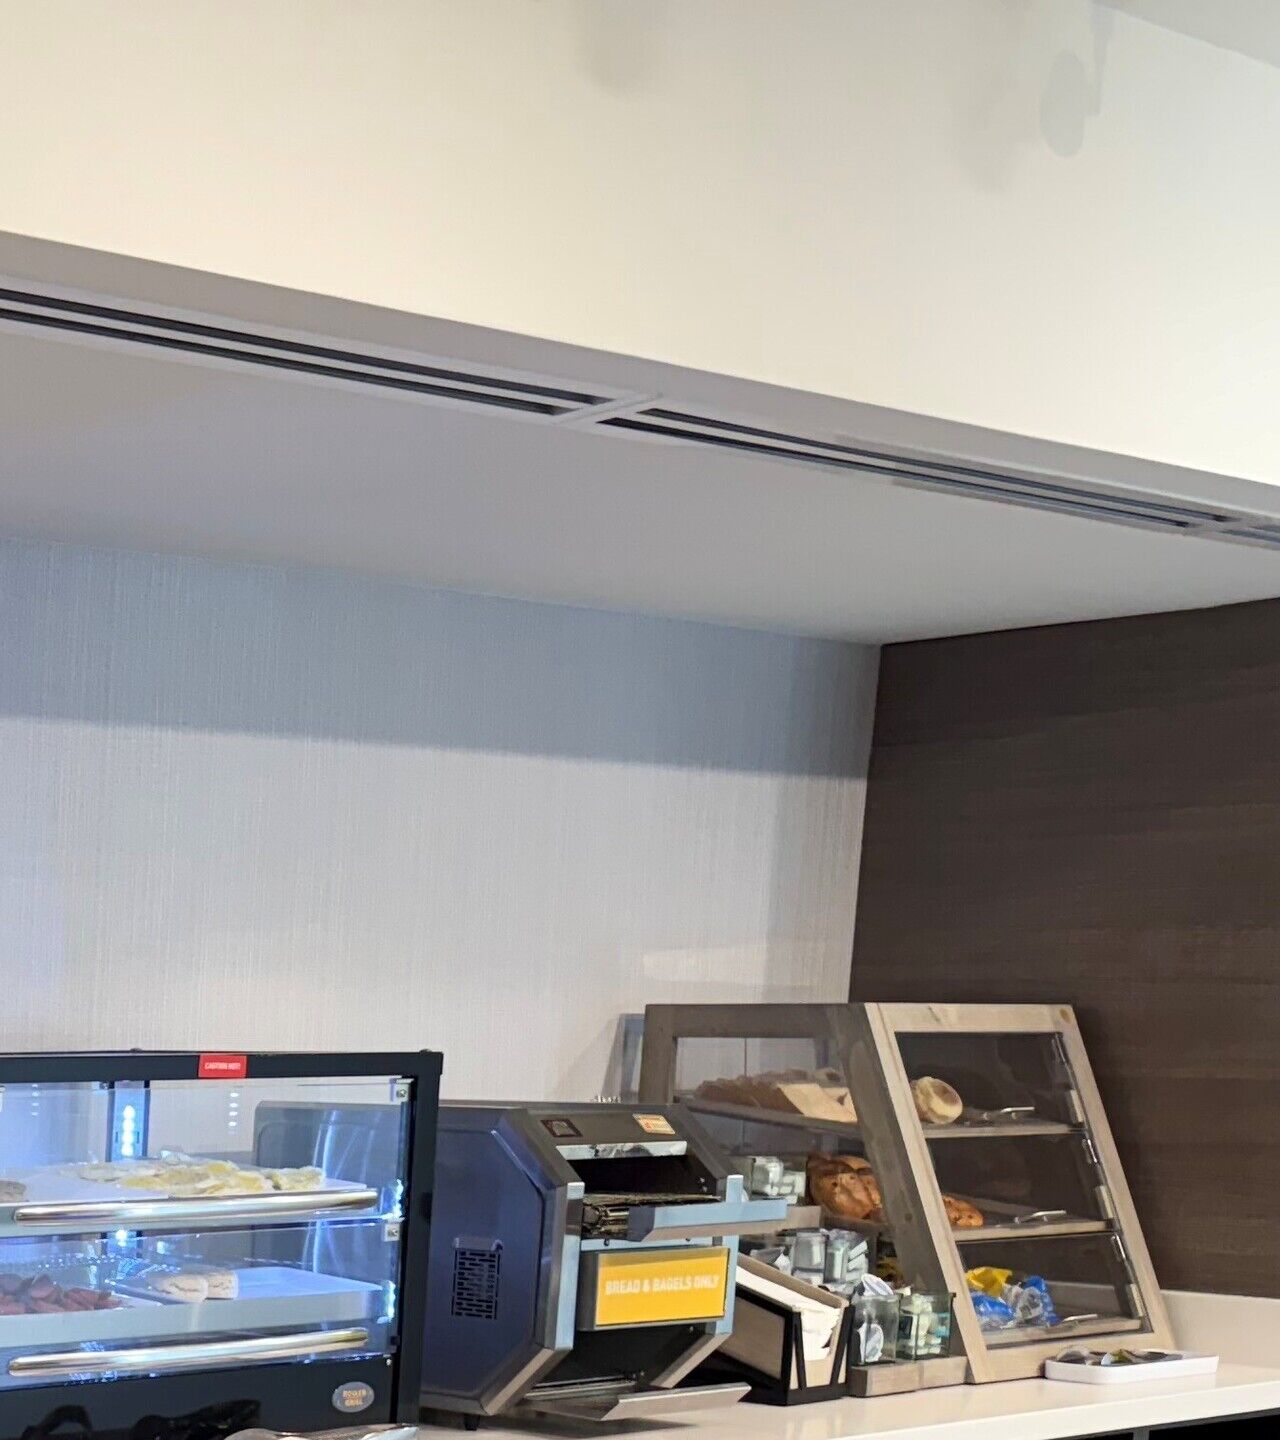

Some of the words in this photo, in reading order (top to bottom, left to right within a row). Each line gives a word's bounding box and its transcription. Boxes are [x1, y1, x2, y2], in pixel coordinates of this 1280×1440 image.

[605, 1279, 640, 1296] BREAD
[652, 1276, 692, 1293] BAGELS
[693, 1274, 720, 1289] ONLY
